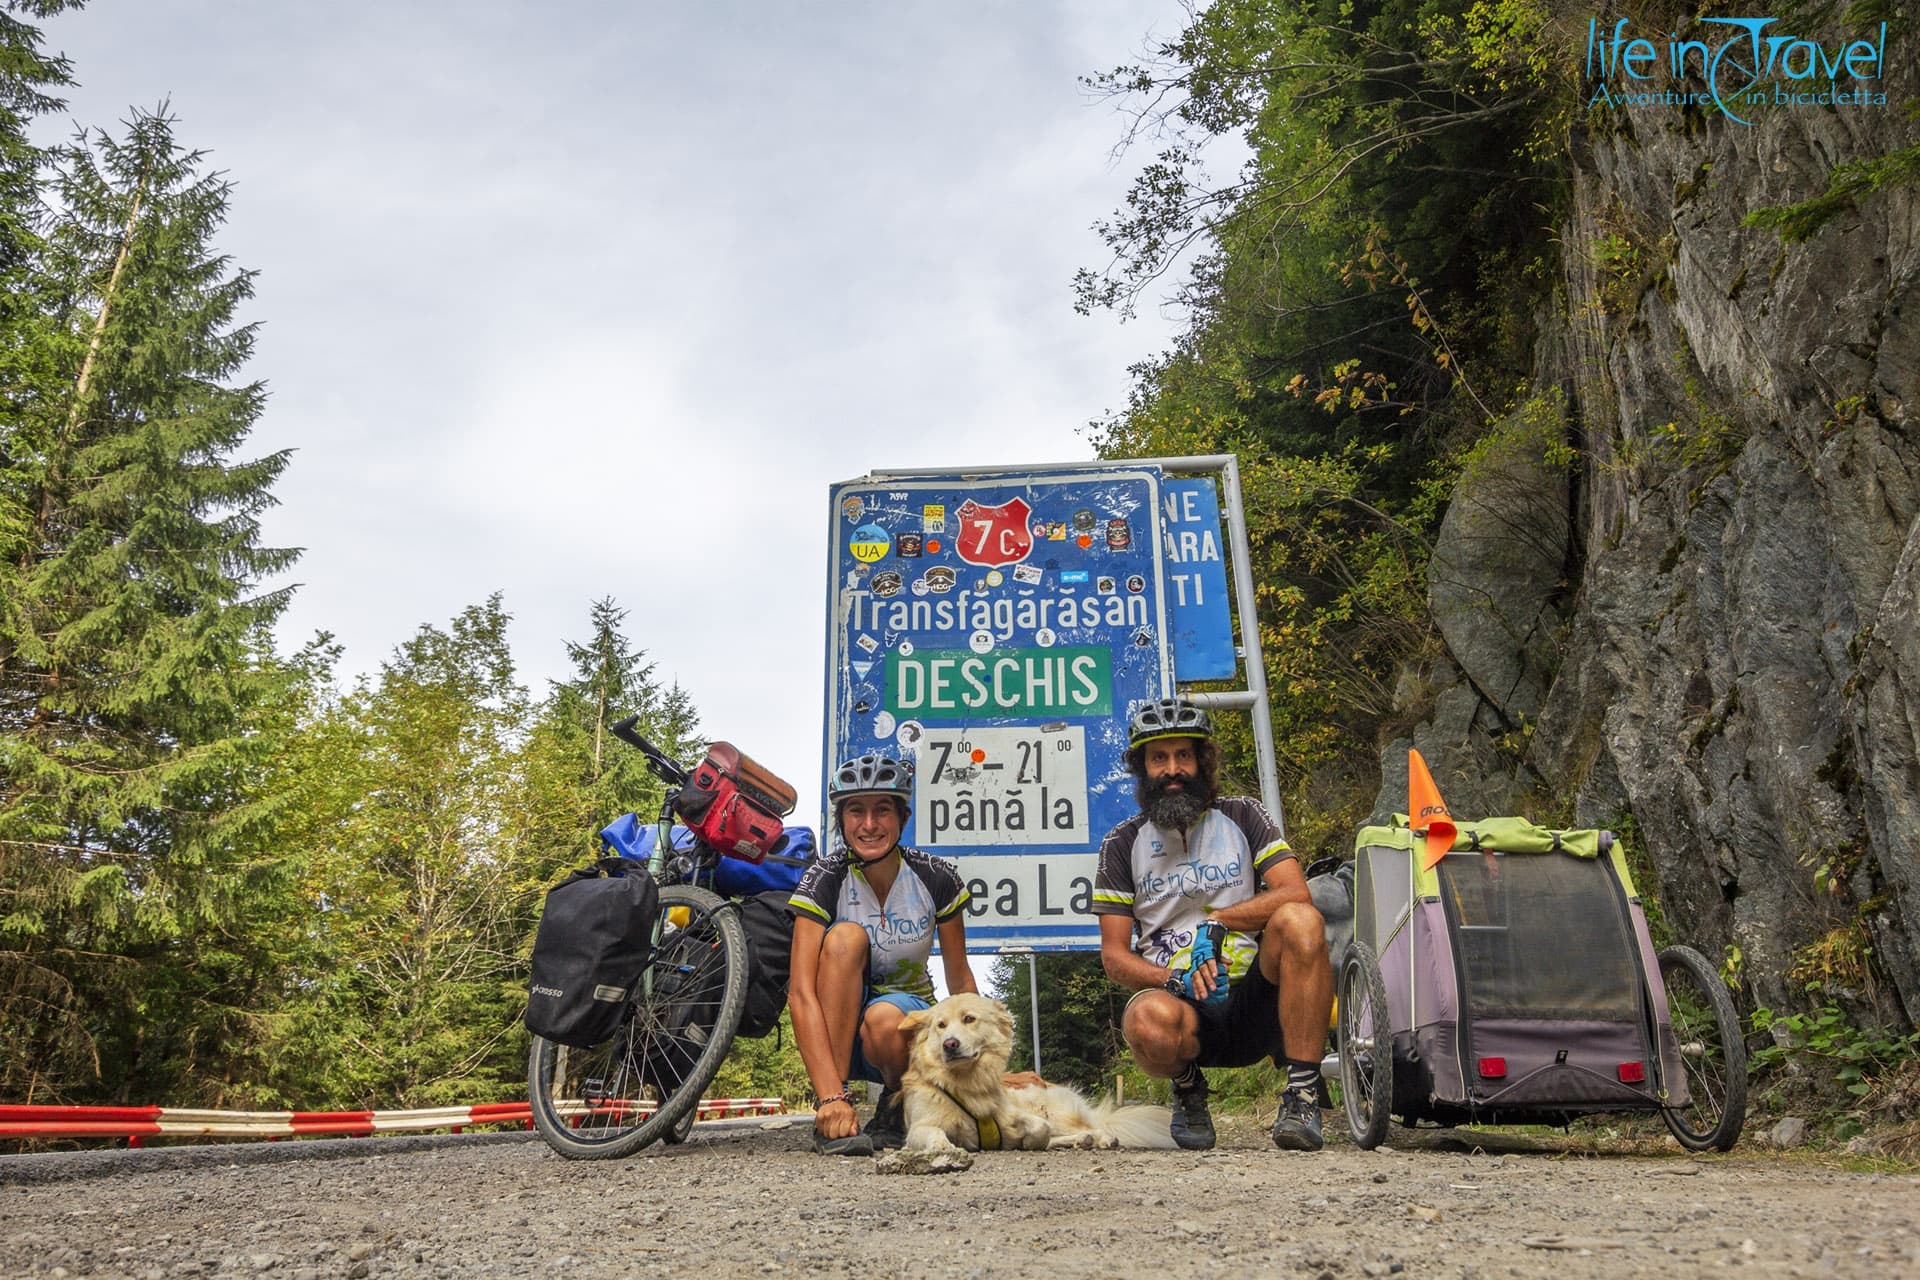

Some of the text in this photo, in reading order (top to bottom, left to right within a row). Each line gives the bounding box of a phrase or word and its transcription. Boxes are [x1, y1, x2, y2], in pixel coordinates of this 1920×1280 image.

[856, 545, 880, 558] UA
[1171, 573, 1204, 606] TI
[898, 655, 1099, 709] DESCHIS
[1041, 787, 1074, 829] la
